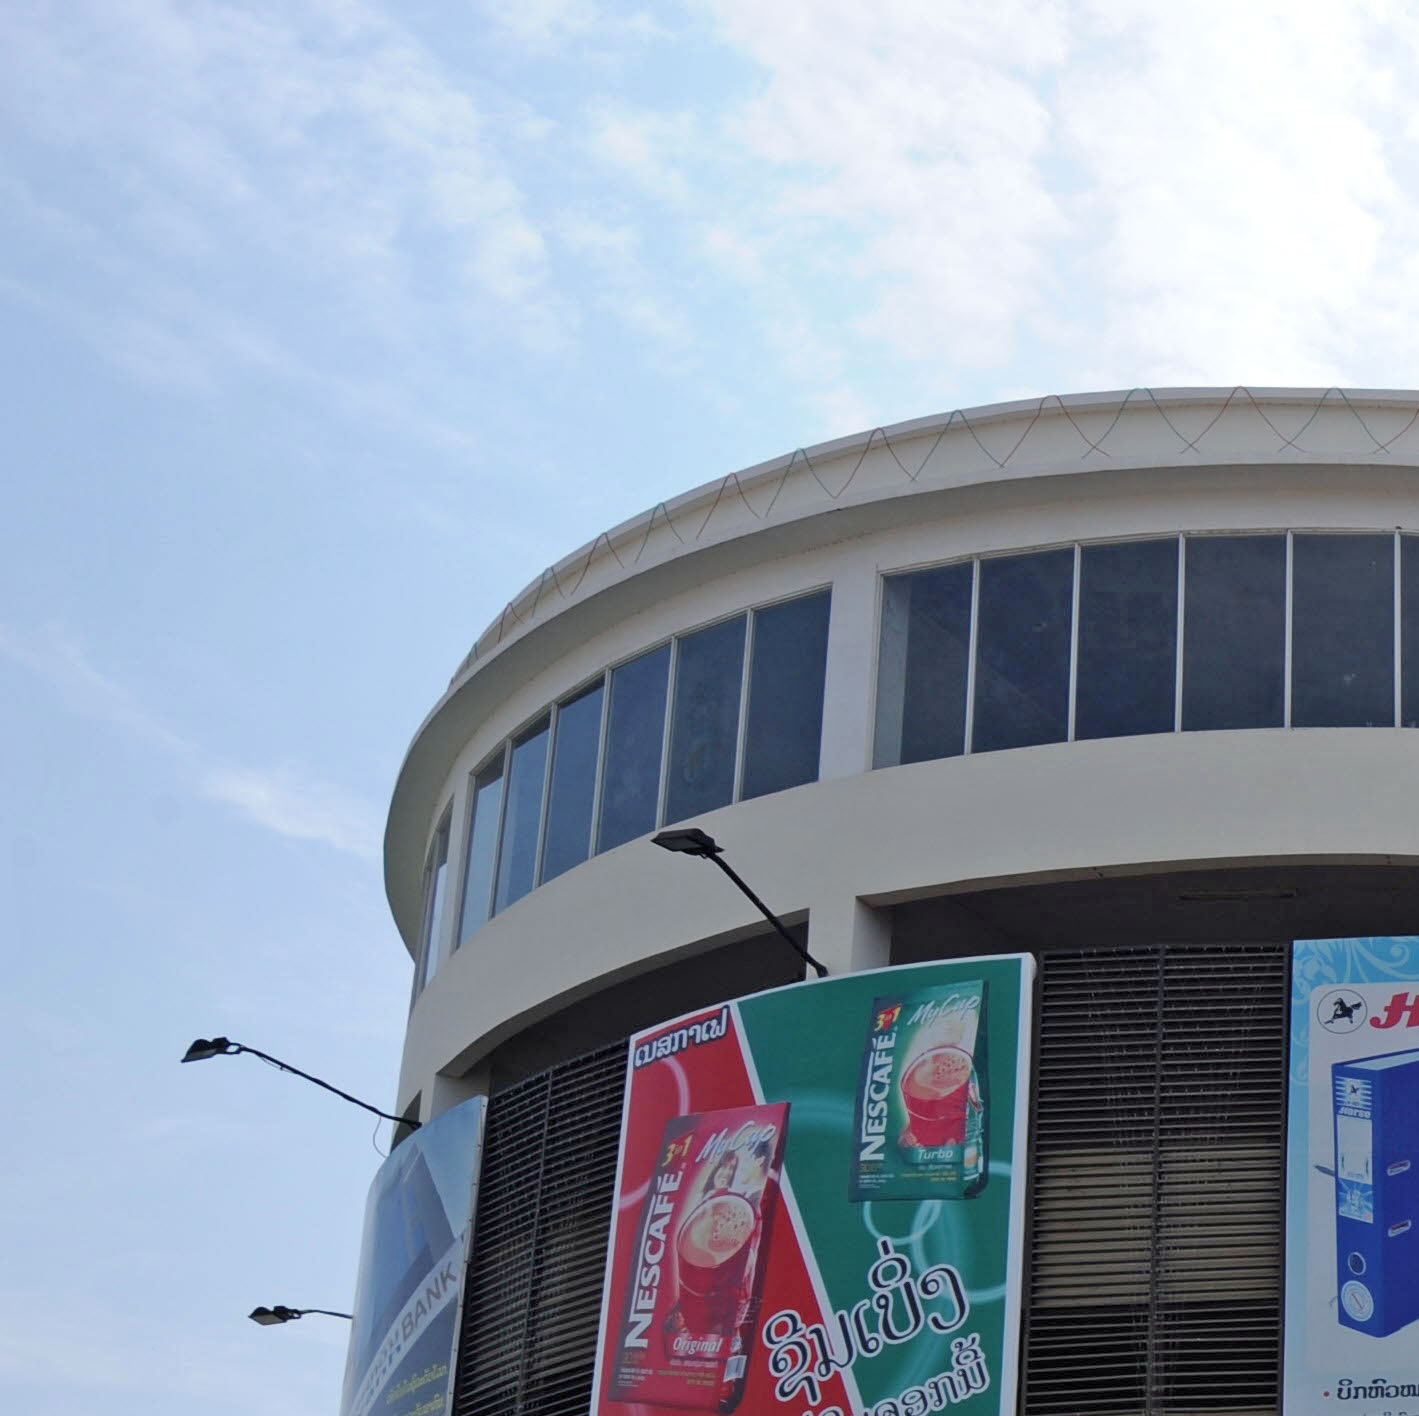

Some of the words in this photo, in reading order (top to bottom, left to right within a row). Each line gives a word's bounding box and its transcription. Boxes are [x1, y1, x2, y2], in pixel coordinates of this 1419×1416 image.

[859, 1034, 896, 1161] NESCAFÉ
[1338, 1106, 1372, 1119] Horse
[917, 1148, 954, 1160] Turbo
[624, 1168, 684, 1349] NESCAFÉ
[401, 1261, 457, 1341] BANK
[672, 1335, 724, 1355] Original
